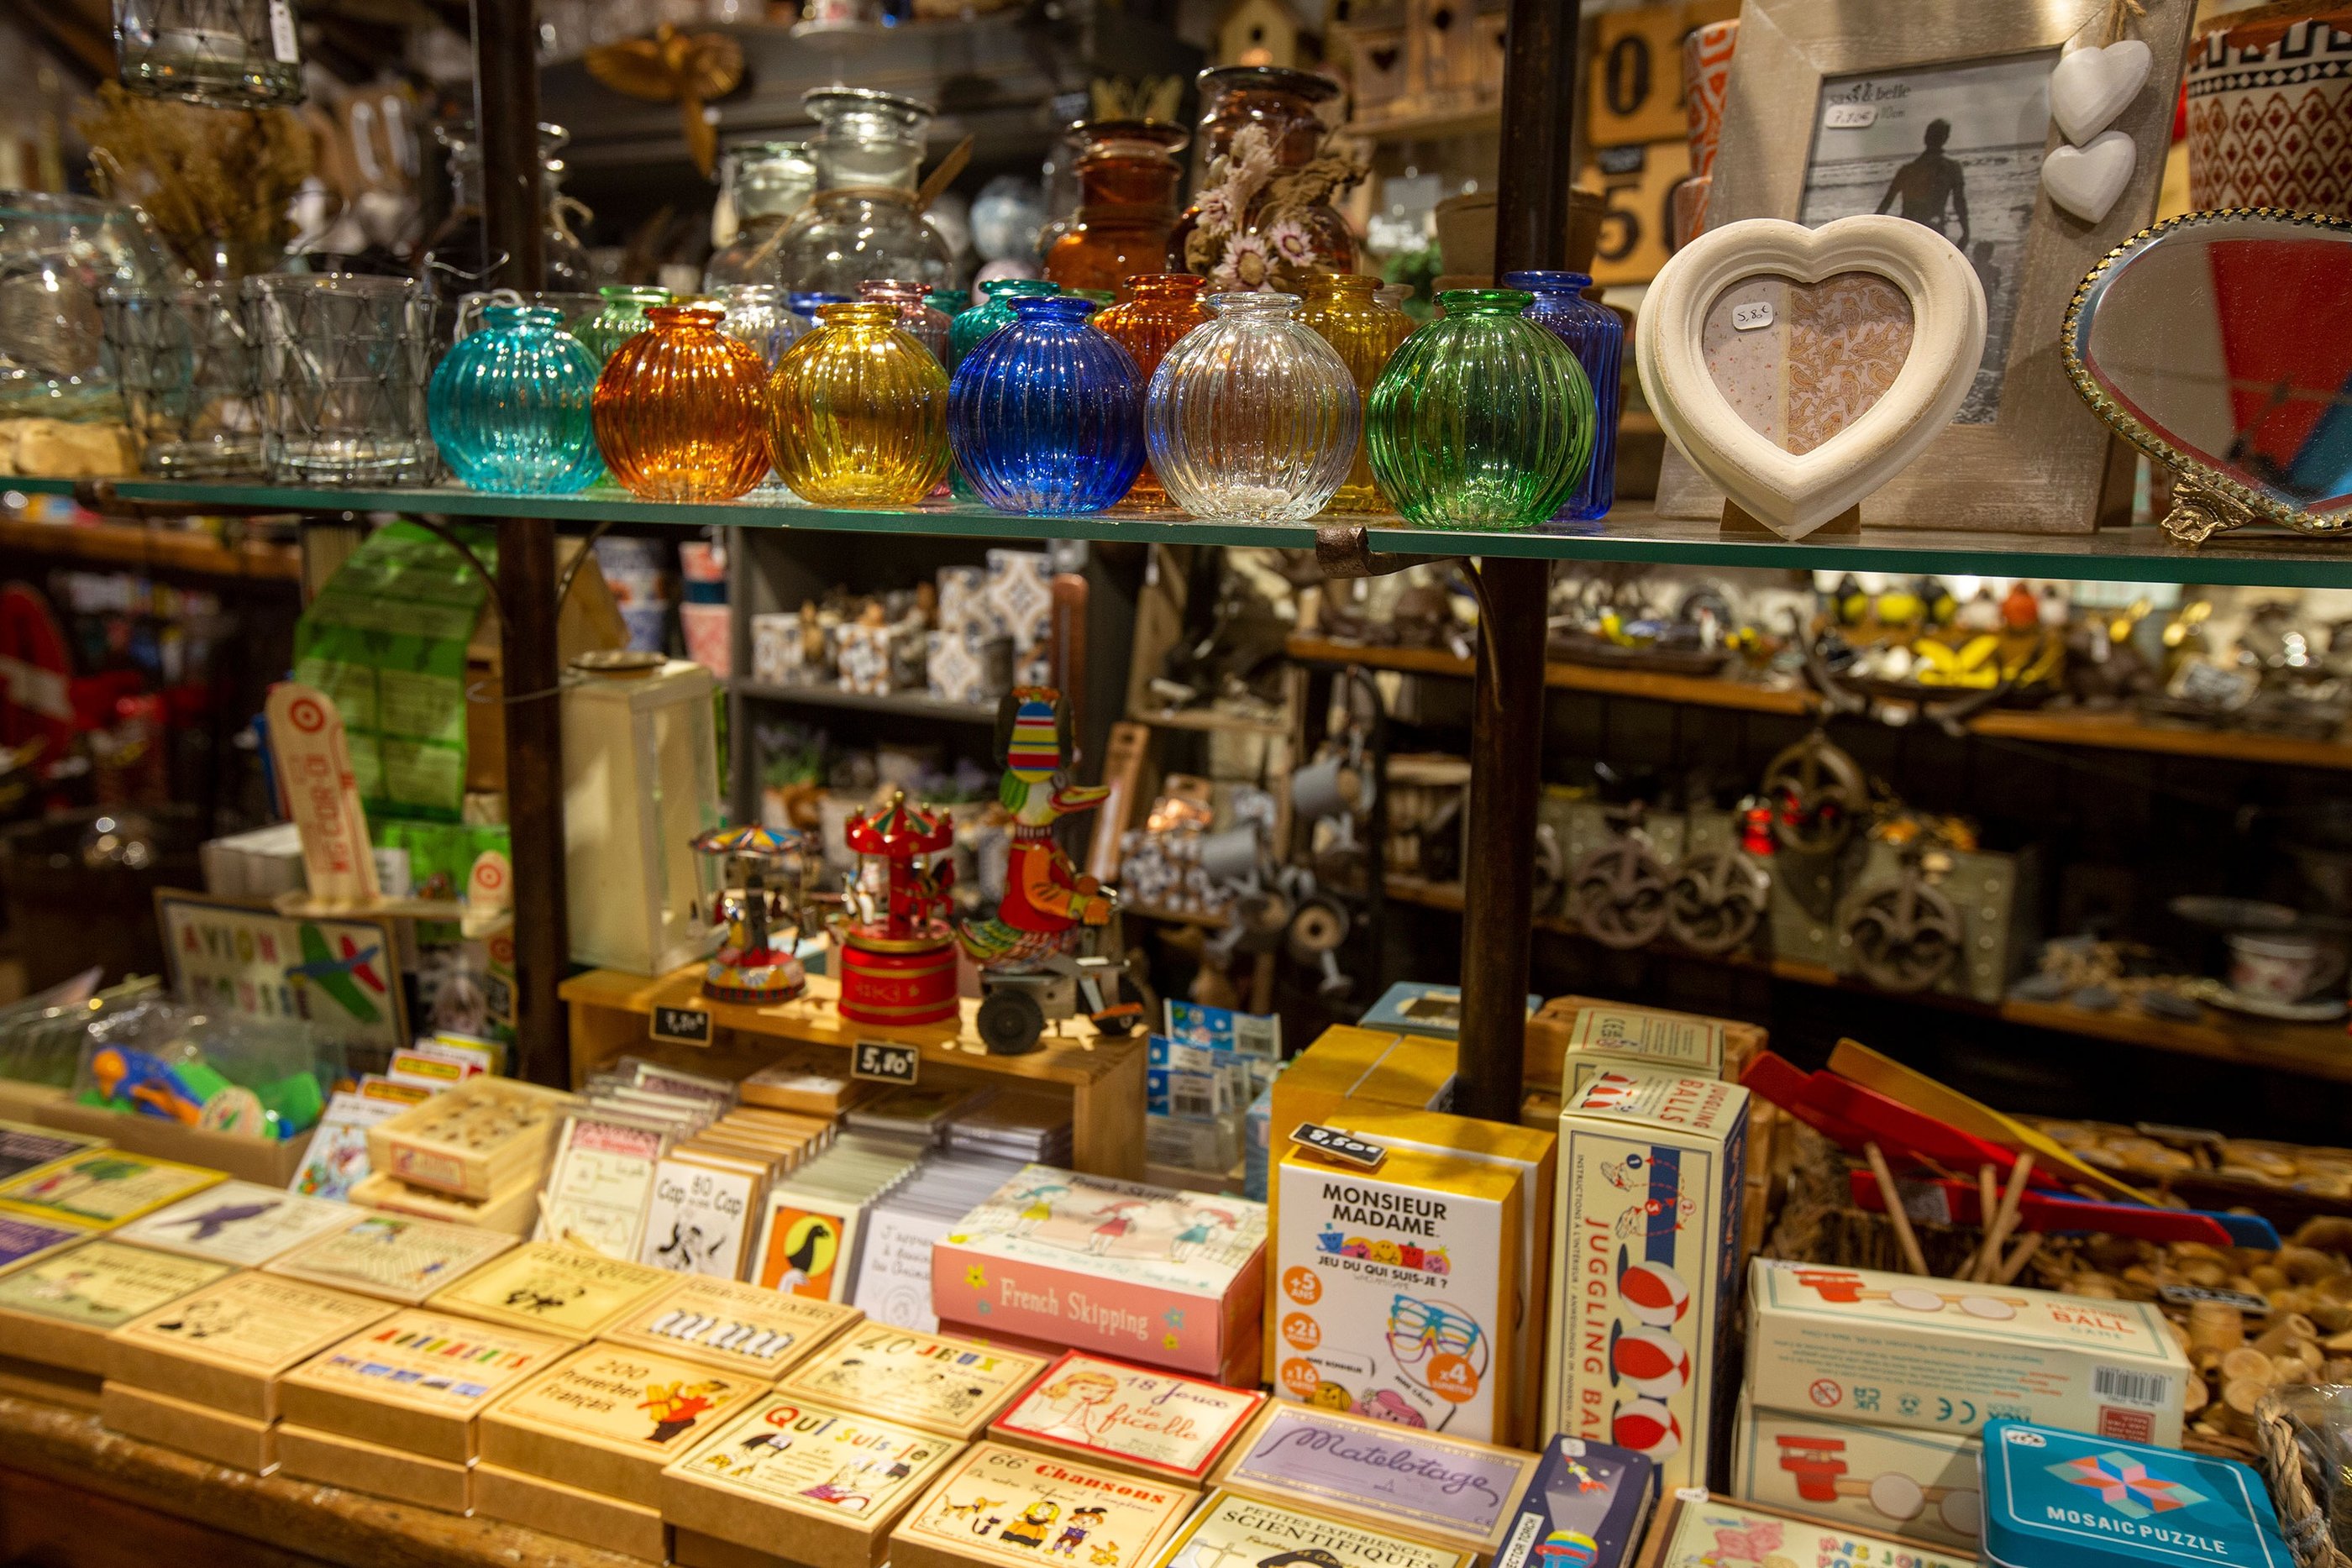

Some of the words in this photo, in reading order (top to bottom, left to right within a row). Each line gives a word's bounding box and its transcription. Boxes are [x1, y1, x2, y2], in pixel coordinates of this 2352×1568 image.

[1660, 1078, 1706, 1125] BALLS
[1693, 1083, 1730, 1130] JUGGLING
[1322, 1183, 1447, 1221] MONSIEUR
[1332, 1204, 1436, 1239] MADAME
[1317, 1254, 1339, 1267] JEU
[1343, 1260, 1361, 1272] DU
[1364, 1264, 1389, 1277] QUI
[1391, 1269, 1437, 1287] SUIS-JE
[1000, 1277, 1059, 1317] French
[1068, 1290, 1149, 1341] Skipping
[1584, 1217, 1610, 1375] JUGGLING
[2051, 1310, 2137, 1335] BALL
[916, 1344, 1003, 1373] JEUX
[1096, 1403, 1200, 1442] ficelle
[1580, 1387, 1603, 1440] BAL
[988, 1452, 1030, 1471] 66
[1034, 1463, 1168, 1505] Chansons
[1256, 1426, 1499, 1508] Matelotage
[1243, 1504, 1310, 1527] PETITES
[1519, 1517, 1536, 1544] TORCH
[2047, 1506, 2135, 1536] MOSAIC
[2141, 1526, 2229, 1555] PUZZLE
